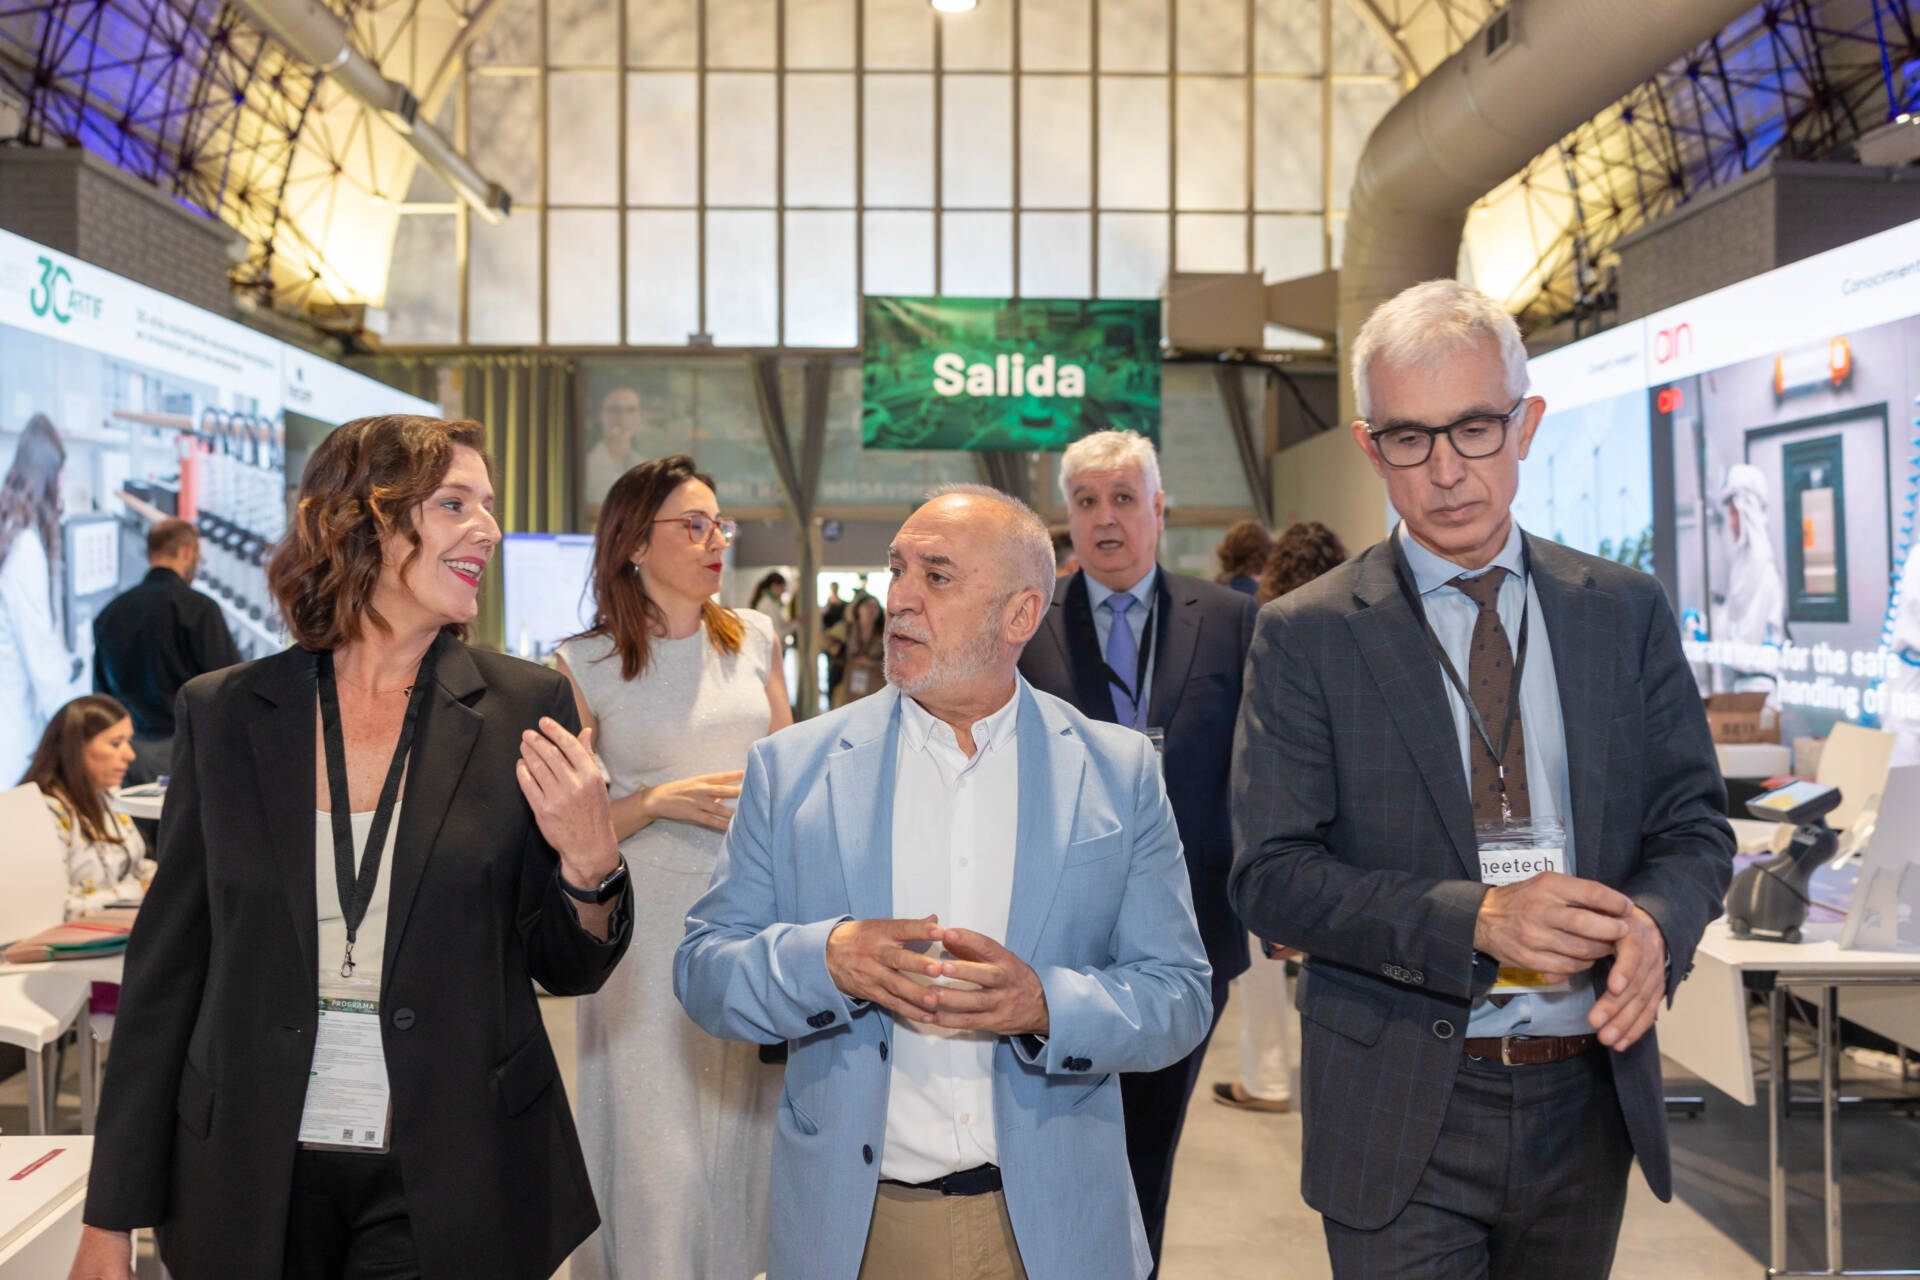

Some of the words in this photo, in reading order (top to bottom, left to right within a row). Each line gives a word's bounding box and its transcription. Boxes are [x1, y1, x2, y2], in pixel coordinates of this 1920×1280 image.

[932, 352, 1086, 397] Salida
[1783, 641, 1809, 670] for
[1812, 643, 1847, 673] the
[1851, 645, 1900, 678] safe
[1777, 672, 1859, 718] handling
[1864, 682, 1888, 714] of
[331, 1000, 375, 1010] PROGRAMA
